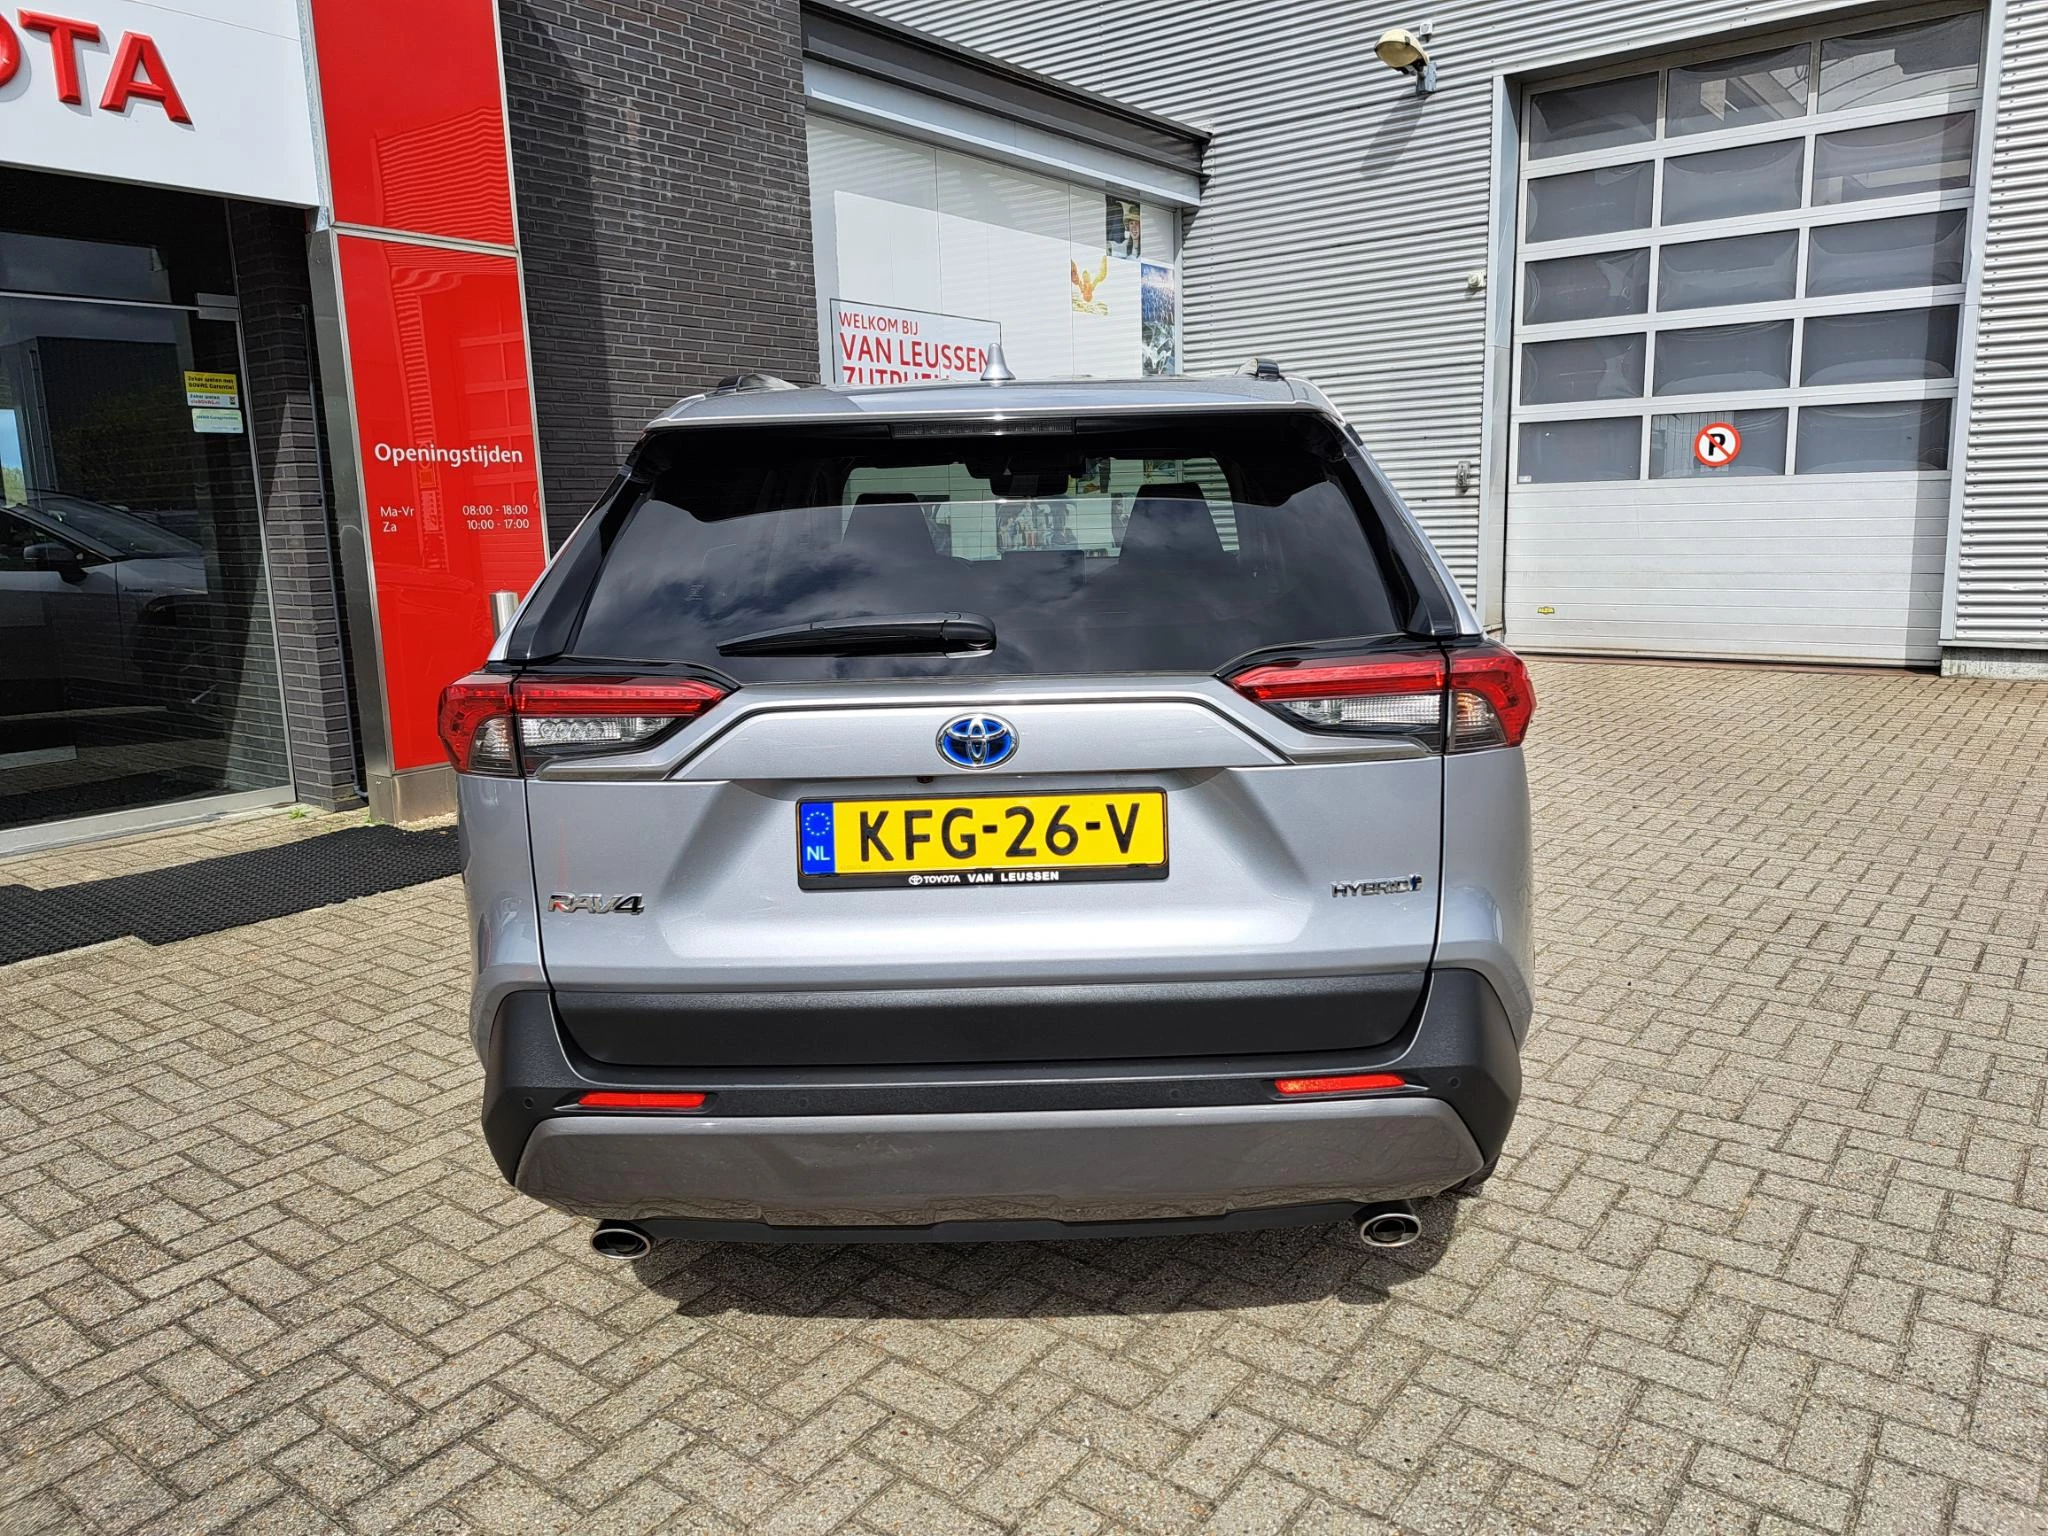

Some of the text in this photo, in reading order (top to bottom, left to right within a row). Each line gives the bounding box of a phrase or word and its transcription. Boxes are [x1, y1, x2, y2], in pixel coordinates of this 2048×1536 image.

[838, 311, 919, 336] WELKOM BIJ
[839, 332, 989, 373] VAN LEUSSEN
[374, 442, 523, 468] Openingstijden
[380, 506, 415, 517] Ma-Vr
[462, 505, 493, 516] 08:00
[502, 504, 528, 515] 18:00
[383, 521, 397, 533] Za
[467, 519, 494, 530] 10:00
[504, 518, 529, 529] 17:00
[858, 802, 1140, 862] KFG-26-V
[806, 846, 831, 861] NL
[924, 871, 1060, 884] TOYOTA VAN LEUSSEN
[1330, 876, 1410, 898] HYBRID
[548, 892, 646, 915] RAV4
